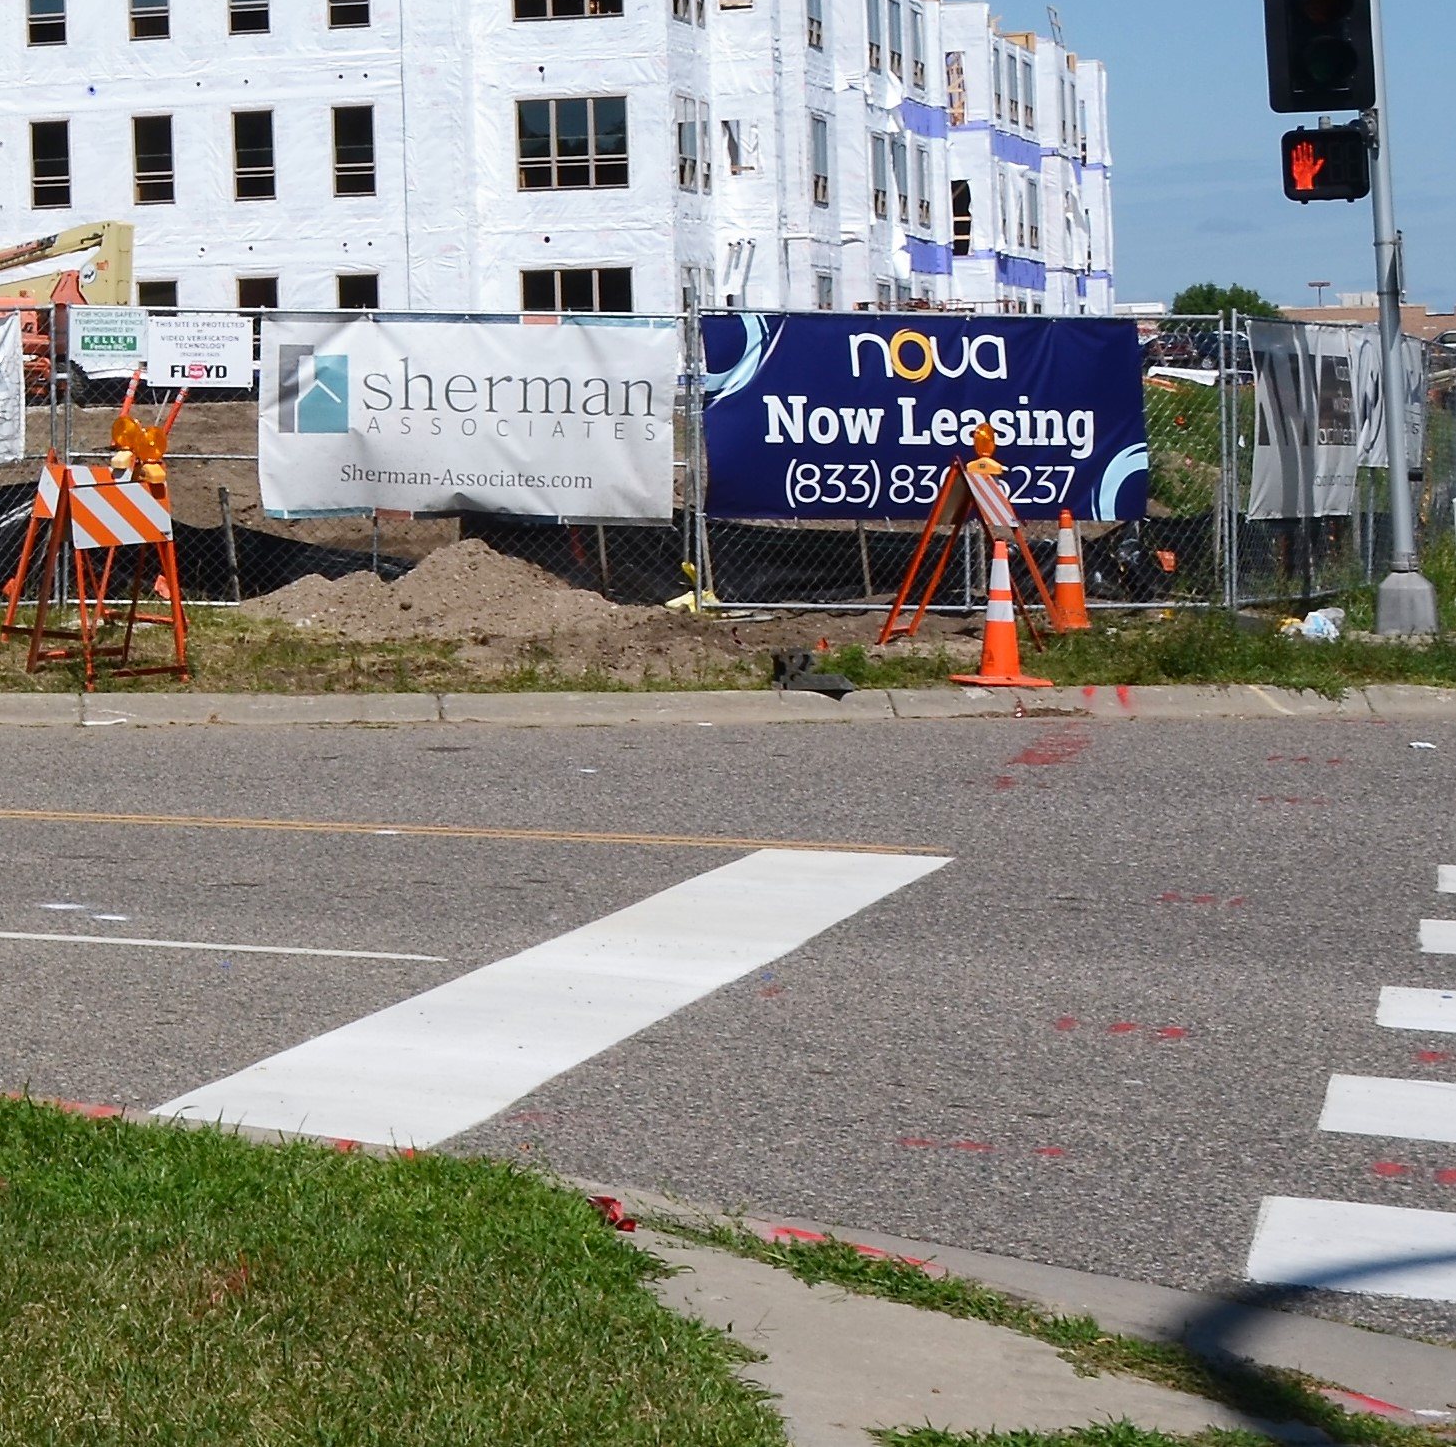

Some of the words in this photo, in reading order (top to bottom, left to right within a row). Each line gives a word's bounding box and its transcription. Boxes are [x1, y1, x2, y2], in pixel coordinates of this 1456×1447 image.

[84, 336, 134, 344] KELLER
[362, 356, 655, 417] sherman
[367, 416, 655, 440] ASSOCIATES
[763, 395, 884, 444] Now
[898, 396, 1094, 459] Leasing
[341, 464, 592, 490] Sherman-Associates.com
[785, 459, 881, 508] (833)
